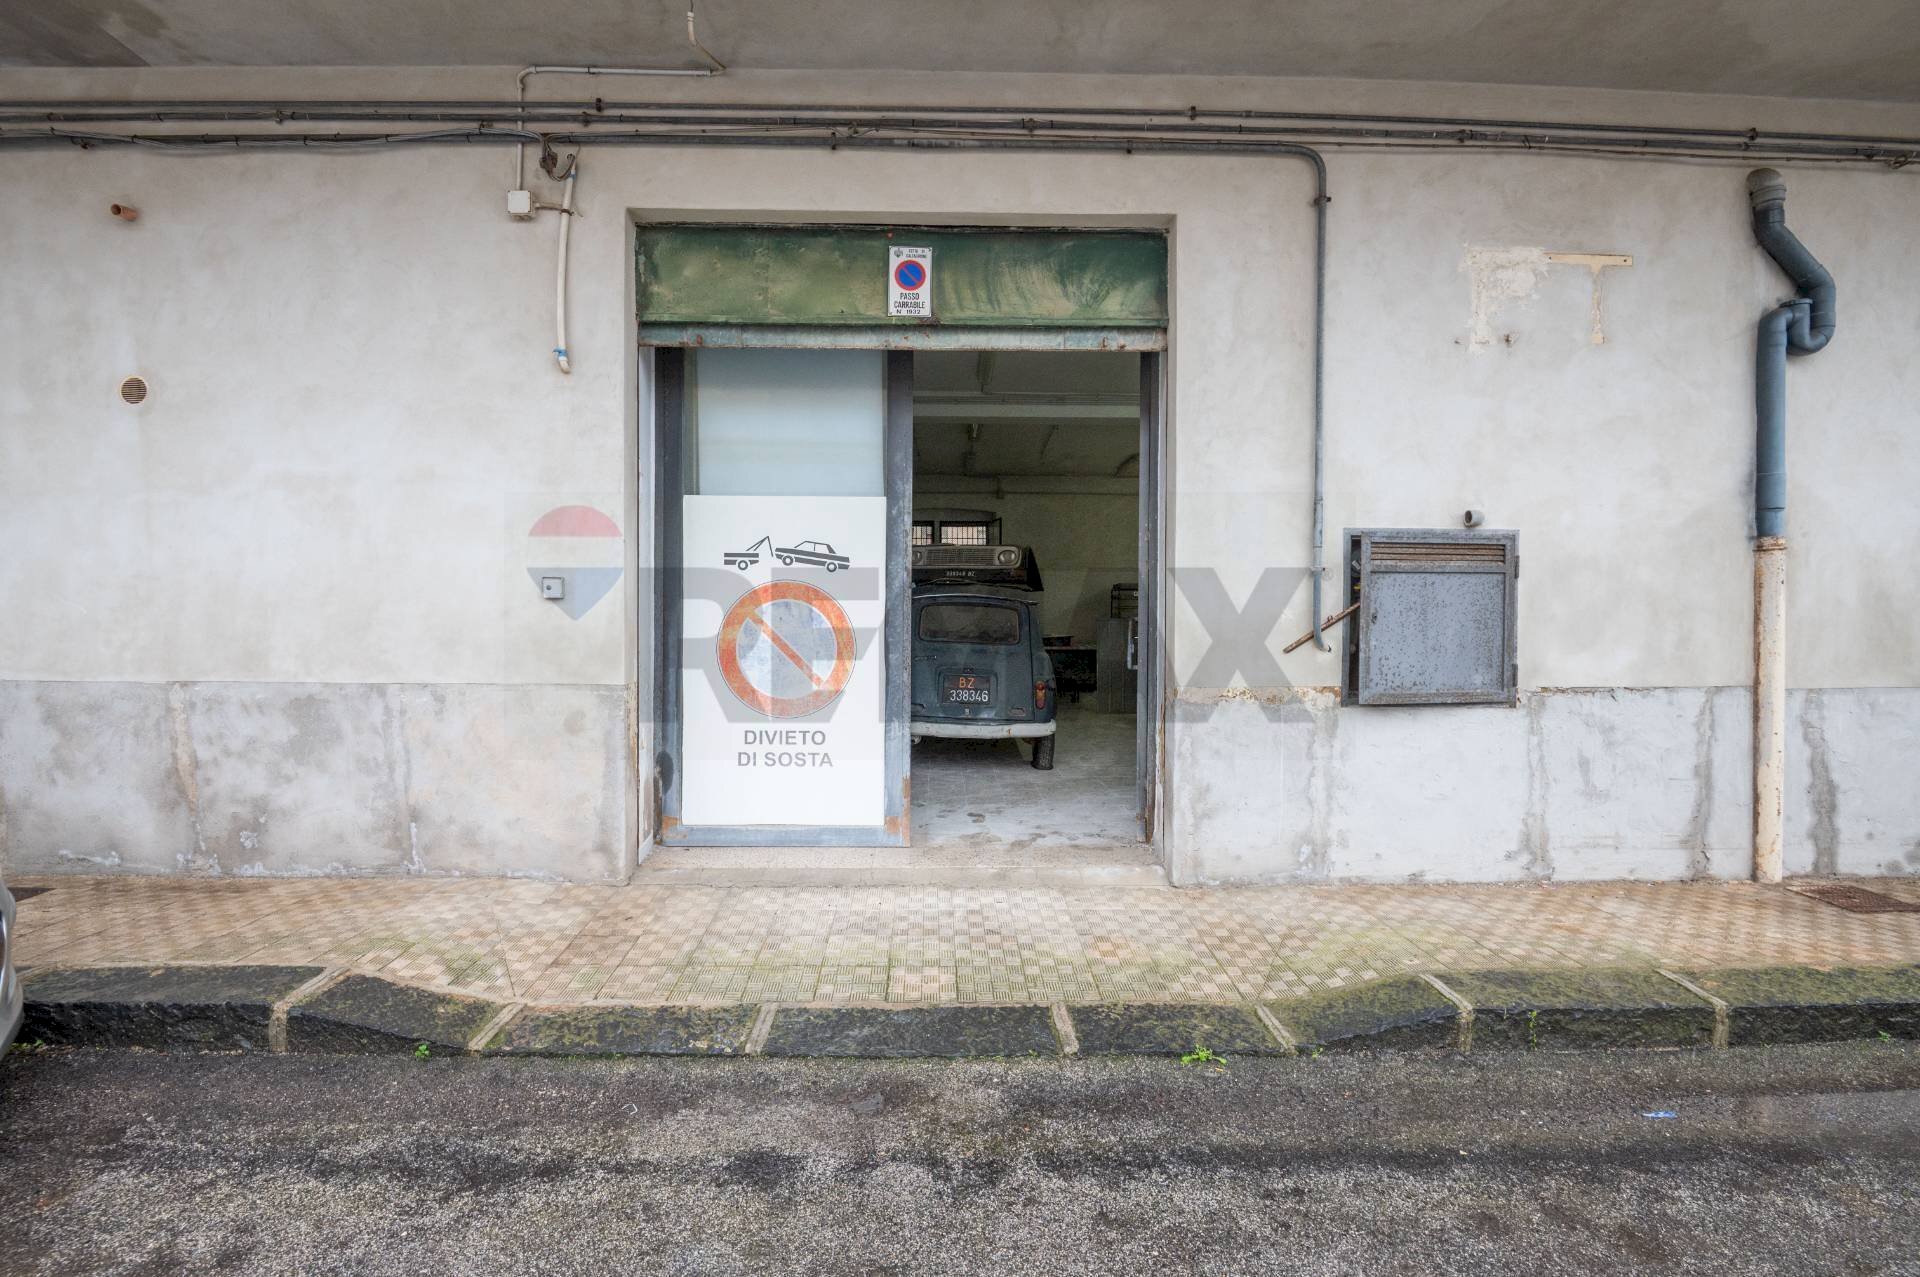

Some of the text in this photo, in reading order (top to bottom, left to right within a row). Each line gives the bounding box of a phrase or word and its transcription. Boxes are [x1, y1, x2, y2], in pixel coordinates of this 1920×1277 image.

[900, 292, 920, 300] PASSO
[894, 301, 926, 309] CARRABILE
[959, 677, 975, 688] BZ
[950, 690, 989, 702] 338346
[744, 730, 826, 745] DIVIETO
[738, 752, 833, 767] DI SOSTA
